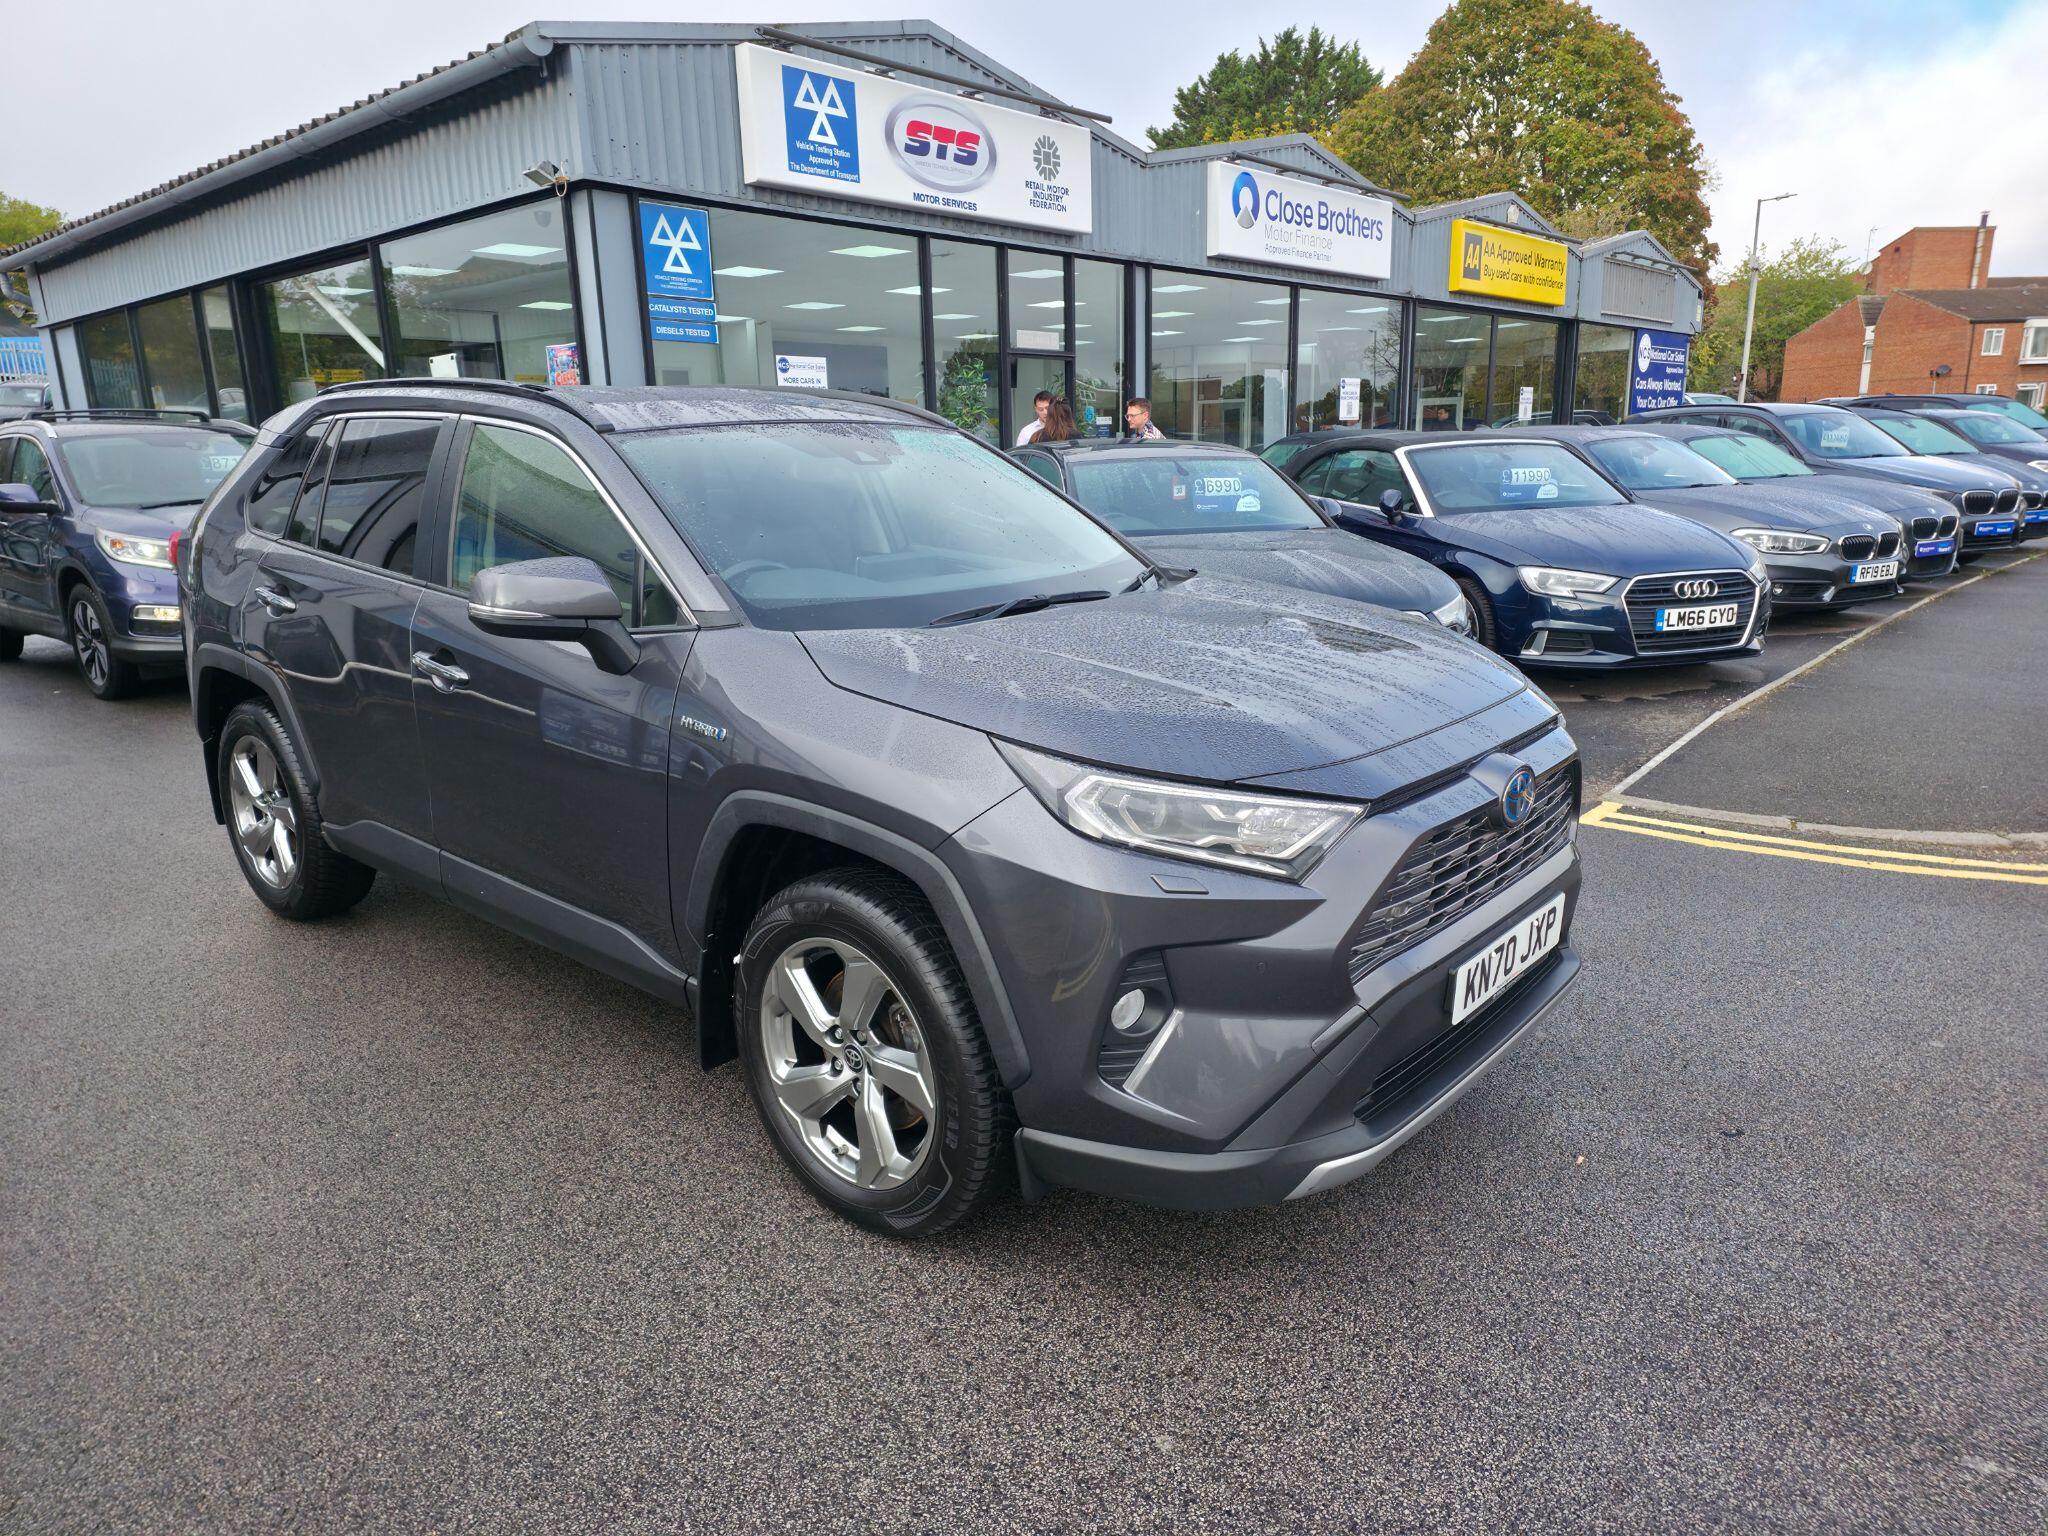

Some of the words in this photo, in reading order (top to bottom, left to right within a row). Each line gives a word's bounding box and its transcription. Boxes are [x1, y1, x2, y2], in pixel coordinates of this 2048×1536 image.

[795, 140, 814, 151] Vehicle
[815, 144, 833, 156] Testing
[833, 148, 851, 158] Station
[904, 120, 980, 166] STS
[809, 154, 833, 165] Approved
[833, 159, 840, 168] by
[790, 161, 800, 171] The
[801, 163, 830, 176] Department
[830, 169, 836, 177] of
[836, 170, 859, 181] Transport
[1025, 180, 1045, 191] RETAIL
[1047, 184, 1070, 196] MOTOR
[1033, 191, 1063, 203] INDUSTRY
[913, 192, 940, 205] MOTOR
[941, 197, 977, 211] SERVICES
[1030, 199, 1067, 212] FEDERATION
[1265, 189, 1314, 228] Close
[1317, 201, 1383, 241] Brothers
[1264, 224, 1293, 243] Motor
[1295, 229, 1333, 250] Finance
[1265, 243, 1291, 256] Approved
[1465, 243, 1480, 269] AA
[1483, 241, 1495, 259] AA
[1497, 244, 1532, 265] Approved
[1534, 253, 1565, 276] Warranty
[1483, 264, 1495, 281] Buy
[1496, 268, 1510, 280] used
[1511, 272, 1522, 282] cars
[1523, 273, 1535, 285] with
[1536, 275, 1564, 289] confidence
[649, 304, 687, 313] CATALYSTS
[688, 307, 714, 316] TESTED
[656, 326, 683, 335] DIESELS
[685, 328, 710, 337] TESTED
[1650, 349, 1667, 361] National
[1667, 350, 1675, 361] Car
[1675, 351, 1685, 362] Sales
[1635, 377, 1646, 389] Cars
[1647, 377, 1663, 392] Always
[1636, 395, 1647, 408] Your
[1657, 396, 1666, 408] Our
[1860, 566, 1879, 579] RF19
[1880, 564, 1895, 577] EBJ
[1666, 610, 1706, 627] LM66
[1709, 607, 1735, 624] GYO
[681, 715, 718, 737] HYBRID
[1463, 935, 1517, 1010] KN70
[1520, 906, 1556, 963] JXP
